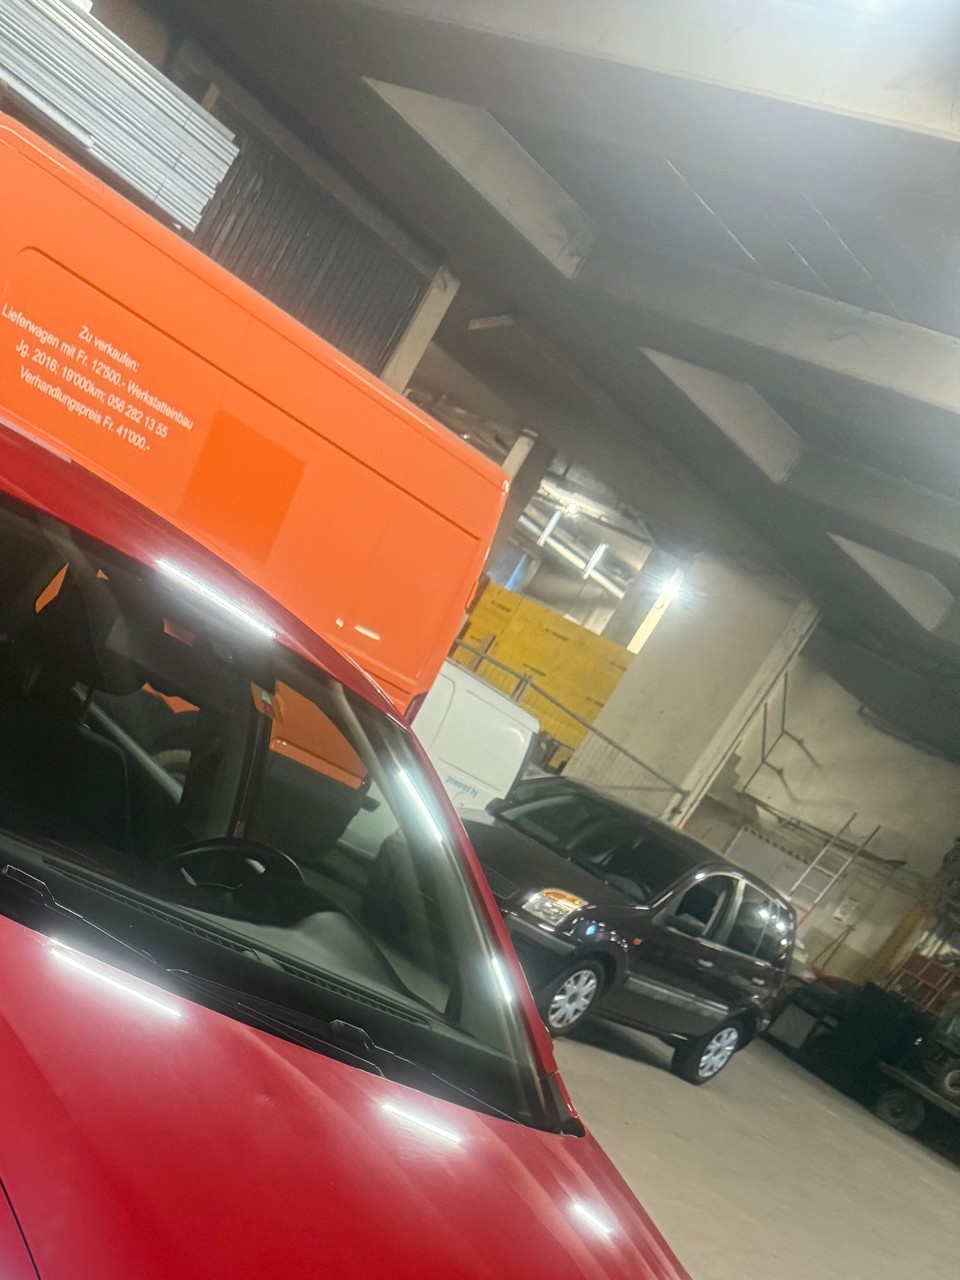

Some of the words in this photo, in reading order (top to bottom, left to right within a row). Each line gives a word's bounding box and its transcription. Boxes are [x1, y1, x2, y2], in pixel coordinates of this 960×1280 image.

[1, 303, 59, 348] Lieferwagen
[60, 340, 76, 356] mit
[76, 351, 88, 367] Fr.
[127, 380, 193, 430] Werkstatteinbau
[15, 340, 30, 358] Jg.
[32, 349, 58, 375] 2016;
[144, 413, 155, 430] 13
[155, 422, 168, 438] 55
[79, 325, 93, 342] Zu
[93, 335, 139, 372] verkaufen:
[20, 365, 102, 424] Verhandlungspreis
[102, 417, 114, 432] Fr.
